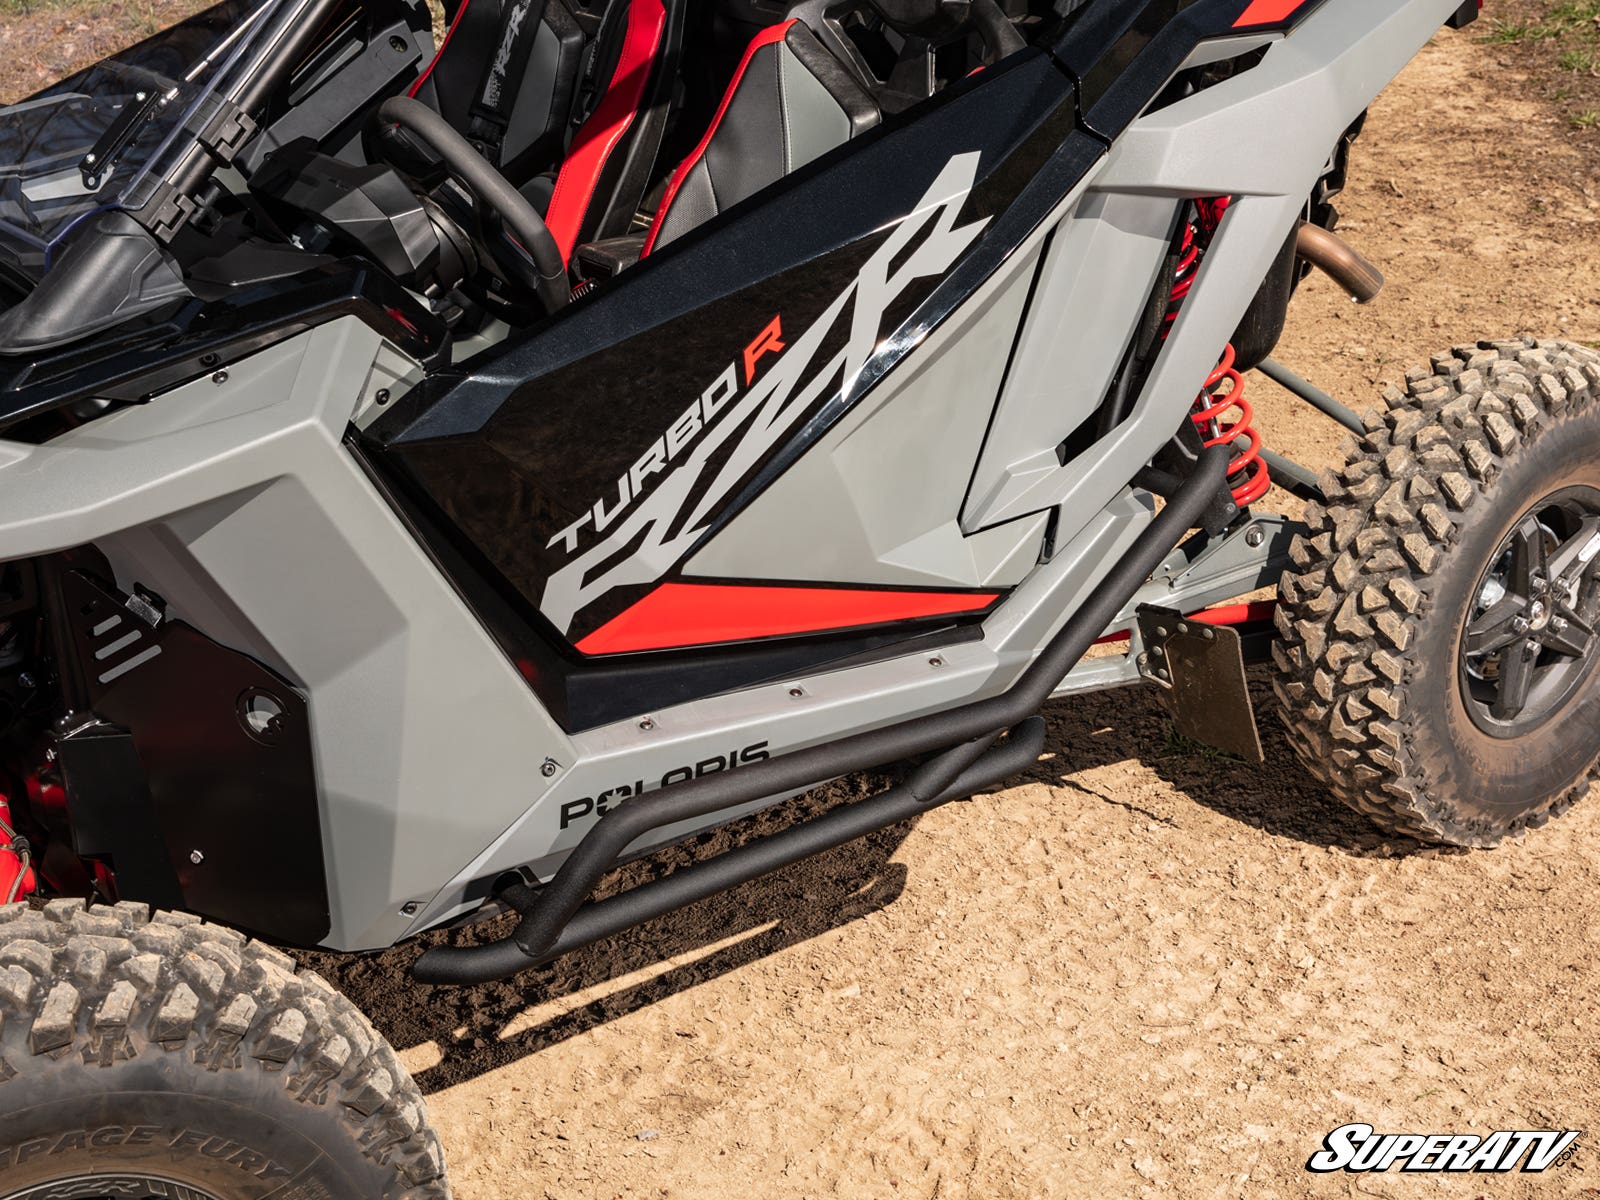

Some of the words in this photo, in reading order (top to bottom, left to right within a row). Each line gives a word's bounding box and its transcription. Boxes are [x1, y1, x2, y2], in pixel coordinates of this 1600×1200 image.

[540, 150, 994, 636] RZR
[545, 361, 738, 553] TURBO
[743, 314, 786, 387] R
[168, 1129, 292, 1180] FURY
